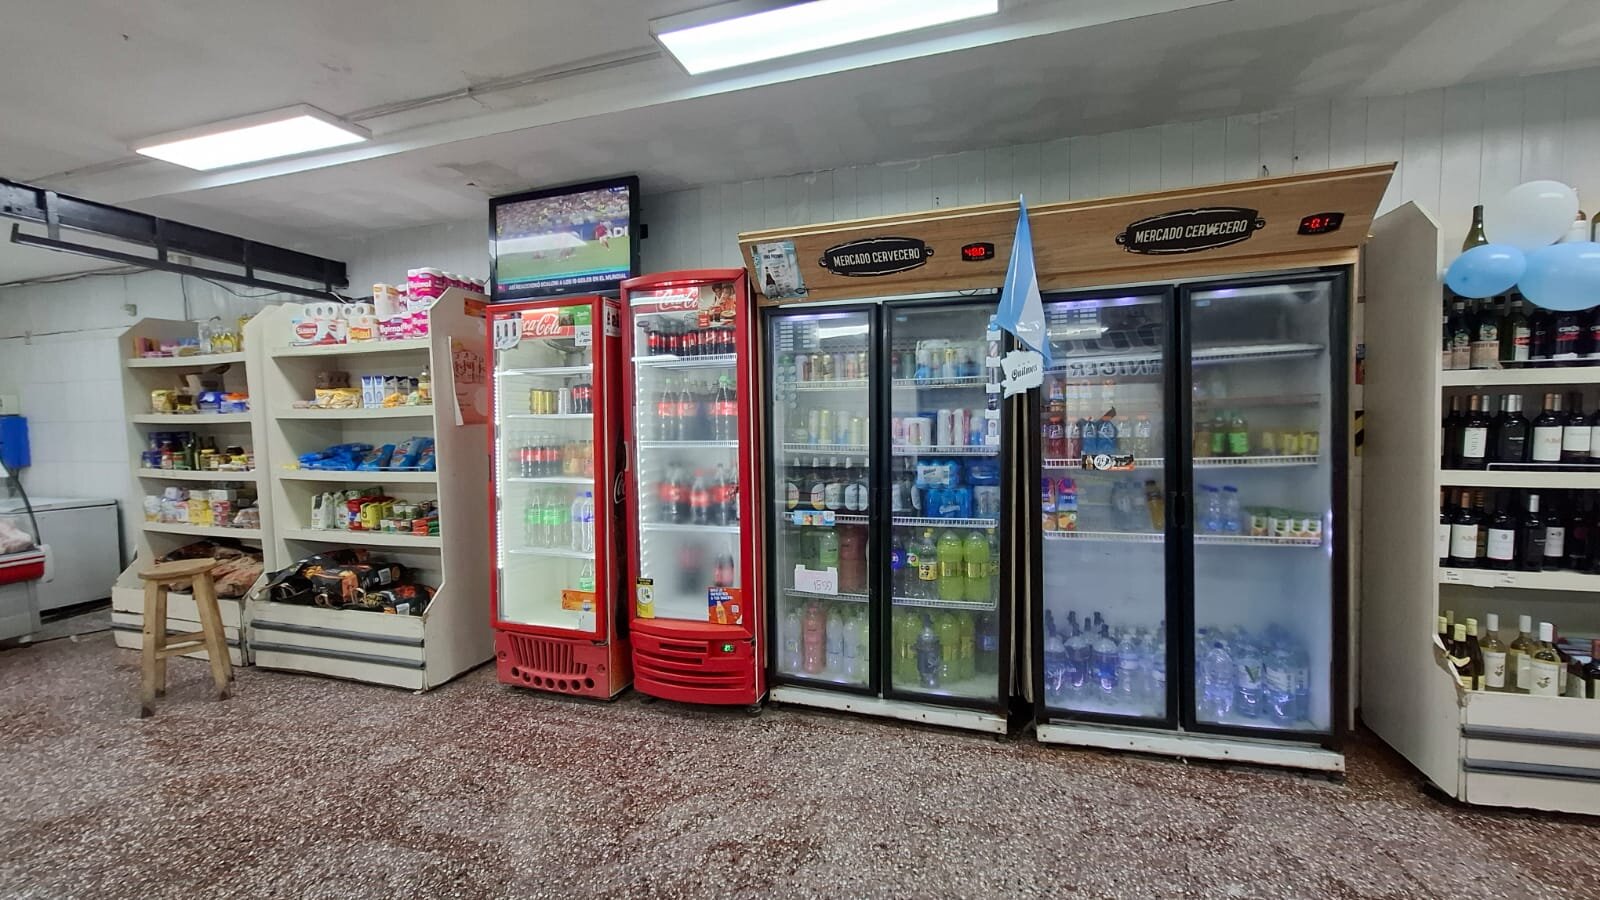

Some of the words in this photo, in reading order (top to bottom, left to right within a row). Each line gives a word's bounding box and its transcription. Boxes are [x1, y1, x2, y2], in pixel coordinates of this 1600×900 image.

[1134, 228, 1183, 244] MERCADO
[1184, 219, 1248, 238] CERVECERO
[833, 252, 871, 268] MERCADO
[872, 247, 921, 264] CERVECERO
